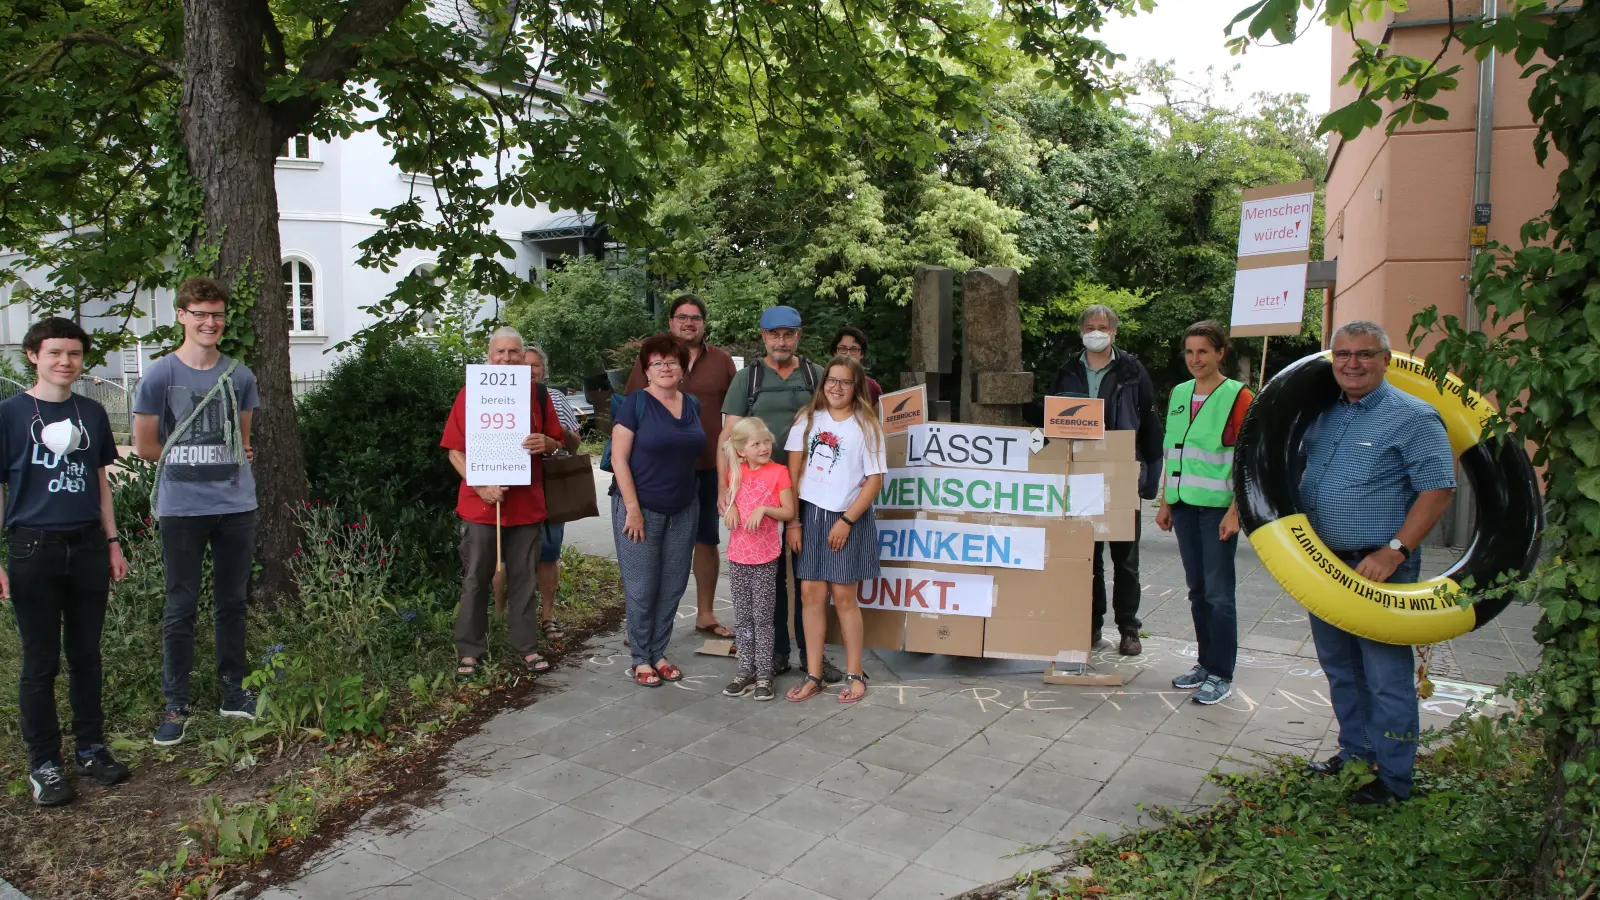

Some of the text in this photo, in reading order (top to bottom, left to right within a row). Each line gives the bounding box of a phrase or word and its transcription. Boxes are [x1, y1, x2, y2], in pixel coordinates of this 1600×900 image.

[1245, 202, 1309, 221] Menschen
[1254, 220, 1301, 242] würde!
[1254, 296, 1280, 307] Jetzt
[480, 372, 517, 386] 2021
[1396, 358, 1479, 411] INTERNTIOAL
[481, 395, 516, 405] bereits
[480, 413, 516, 430] 993
[886, 409, 921, 423] SEEBRÜCKE
[1049, 418, 1099, 427] SEEBRÜCKE
[908, 427, 1017, 466] LÄSST
[471, 462, 527, 472] Ertrunkene
[873, 476, 1071, 513] MENSCHEN
[877, 528, 1022, 565] RINKEN.
[1291, 525, 1405, 610] FLÜCHTLINGSSCHUTZ
[856, 577, 960, 611] UNKT.
[1409, 597, 1437, 610] ZUM
